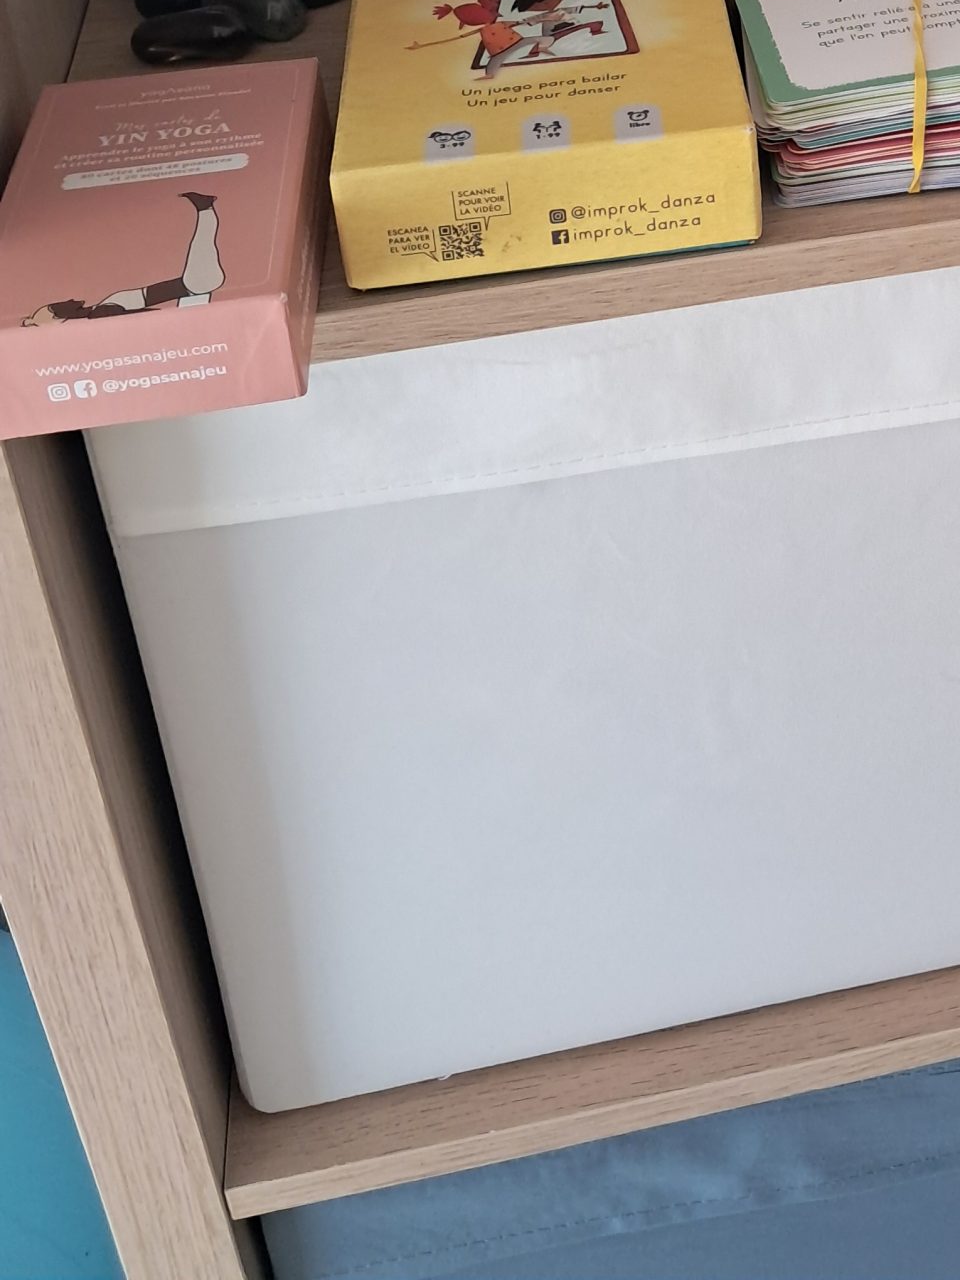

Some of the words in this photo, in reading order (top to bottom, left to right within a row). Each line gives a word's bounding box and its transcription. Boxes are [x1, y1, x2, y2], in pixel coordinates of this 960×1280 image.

[817, 21, 877, 38] partager
[883, 16, 909, 25] une
[827, 13, 866, 24] sentir
[819, 37, 845, 48] que
[881, 26, 912, 39] peut
[487, 84, 532, 97] juego
[539, 78, 576, 91] para
[581, 72, 627, 84] bailar
[493, 95, 518, 107] jeu
[523, 89, 561, 102] pour
[568, 84, 620, 97] danser
[99, 132, 148, 146] YIN
[157, 122, 232, 140] YOGA
[61, 147, 129, 161] Apprendre
[175, 139, 265, 157] personnalisée
[458, 187, 496, 198] SCANNE
[458, 197, 482, 207] POUR
[484, 194, 505, 204] VOIR
[473, 204, 502, 214] VIDÉO
[570, 191, 716, 221] @improk_danza
[387, 226, 429, 237] ESCANEA
[572, 215, 701, 243] improk_danza
[388, 236, 413, 245] PARA
[34, 340, 228, 378] www.yogasanajeu.com
[102, 364, 227, 393] @yogasanajeu
